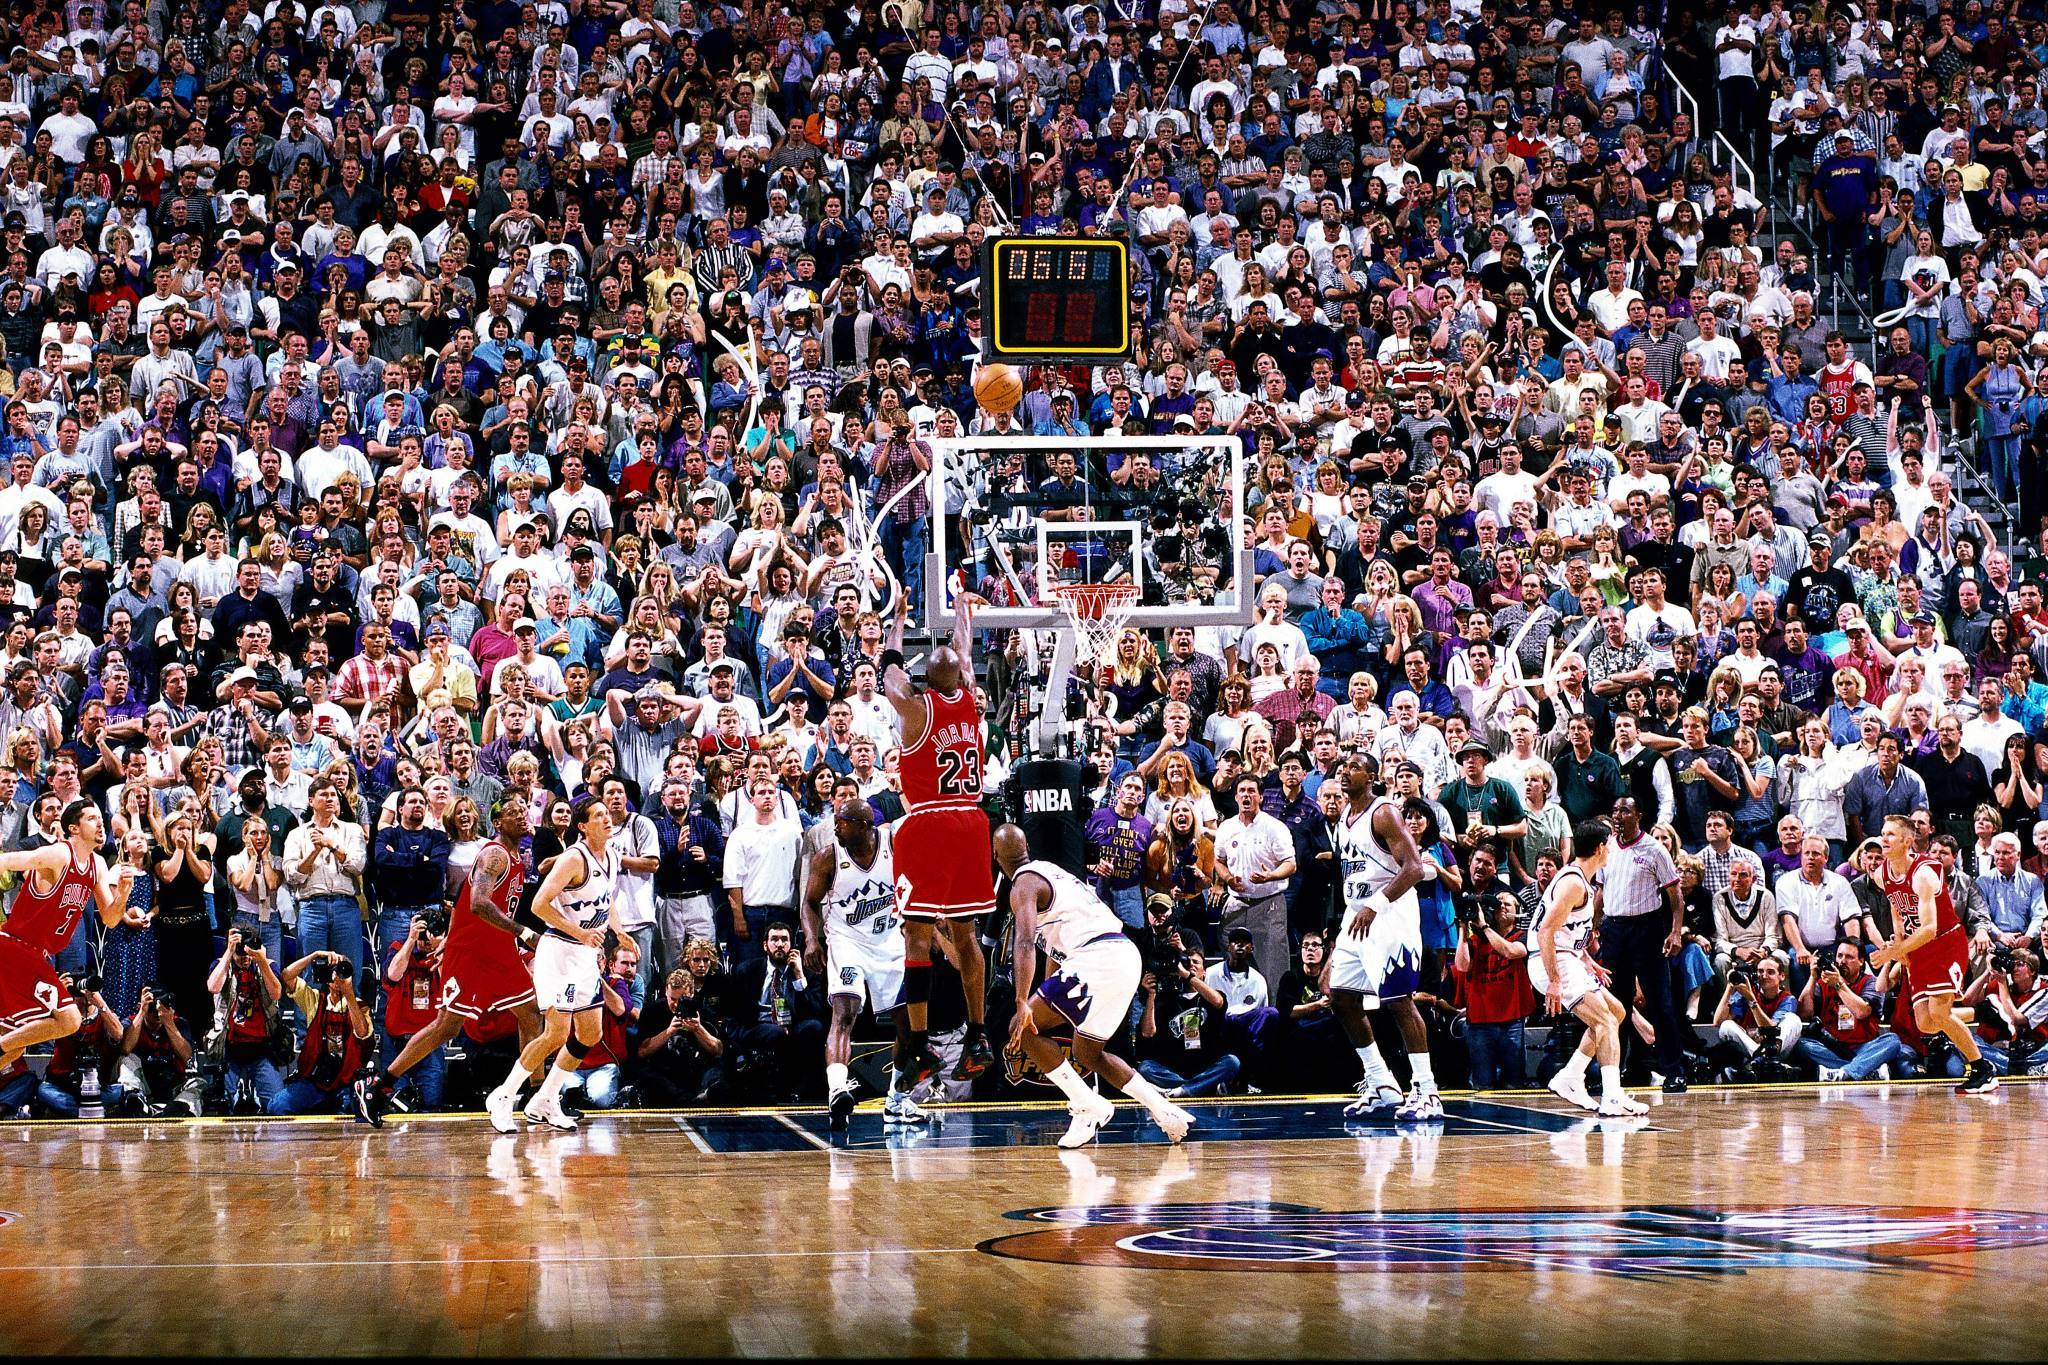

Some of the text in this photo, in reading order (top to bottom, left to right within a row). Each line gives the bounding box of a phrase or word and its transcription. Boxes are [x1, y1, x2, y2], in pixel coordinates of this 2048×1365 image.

[931, 722, 976, 753] JORDA
[936, 747, 983, 796] 23
[1032, 788, 1073, 813] NBA
[1107, 826, 1116, 835] IT
[1113, 836, 1134, 848] OVER
[1111, 869, 1131, 879] INGS
[1346, 881, 1373, 900] 32
[55, 908, 78, 936] 7
